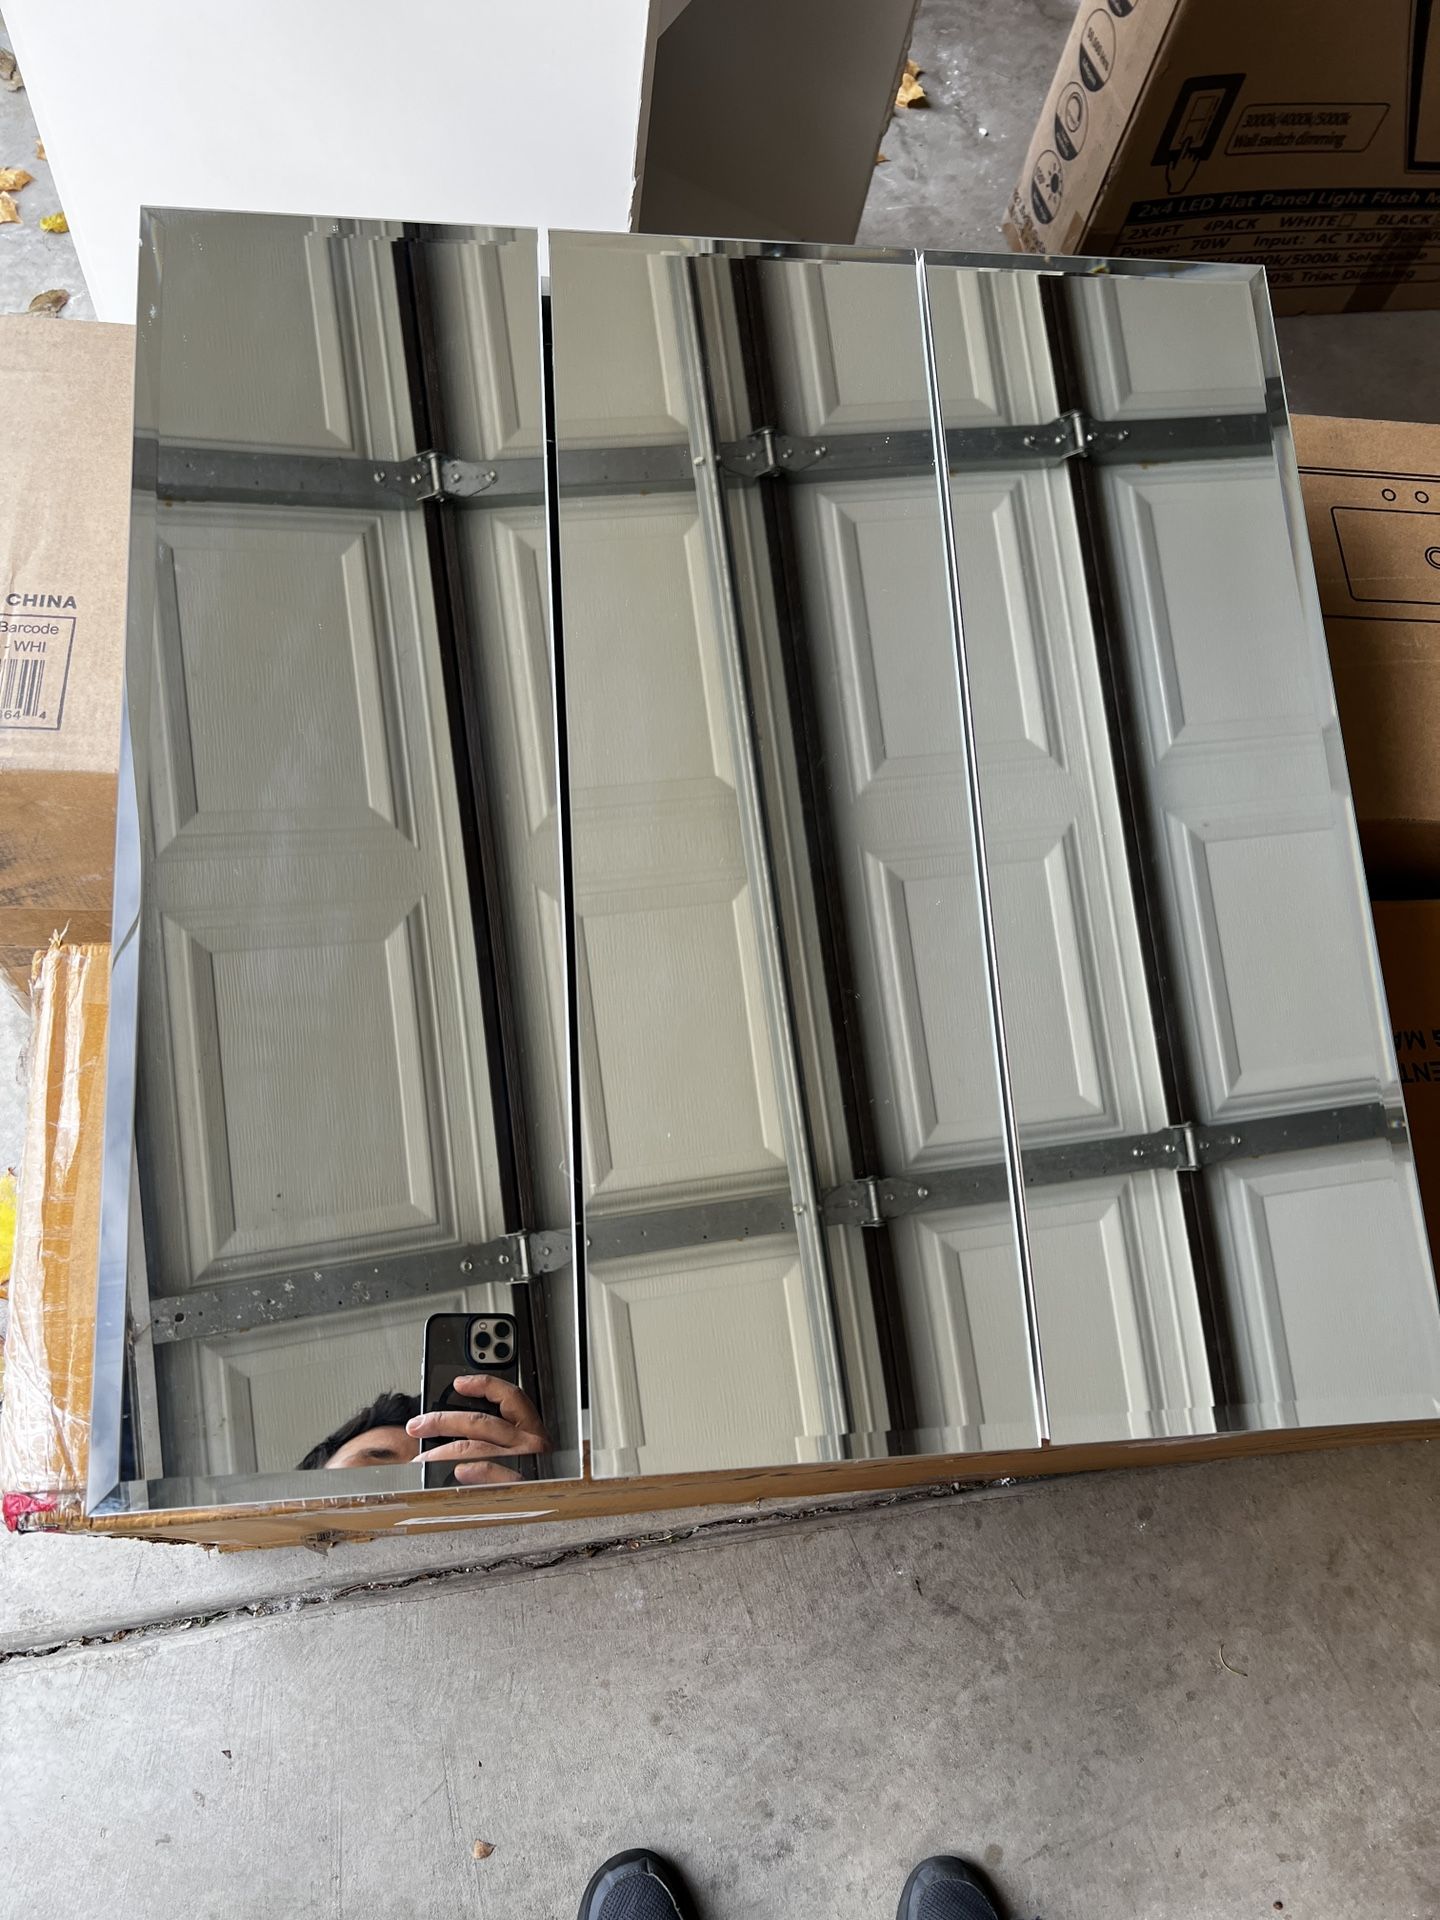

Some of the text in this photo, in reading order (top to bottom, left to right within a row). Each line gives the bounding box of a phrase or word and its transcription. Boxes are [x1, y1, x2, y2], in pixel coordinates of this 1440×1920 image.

[1233, 131, 1346, 148] Wall switch dimming
[1138, 201, 1173, 217] 2x4
[1180, 196, 1214, 214] LED
[1218, 194, 1257, 209] Flat
[1259, 191, 1315, 207] Panel
[1317, 192, 1368, 207] Light
[1370, 190, 1420, 205] Flush
[1128, 214, 1434, 239] 2X4FT 4PACK WHITE BLACK
[1120, 244, 1180, 257] Power:
[1191, 237, 1232, 251] 70W
[1254, 235, 1305, 249] Input:
[1314, 233, 1341, 244] AC
[1345, 232, 1388, 244] 120V
[1270, 273, 1296, 284] 0%
[1300, 271, 1338, 283] Triac
[6, 593, 77, 610] CHINA
[0, 621, 59, 635] Barcode
[14, 640, 47, 653] WHI
[0, 709, 47, 720] 64 4
